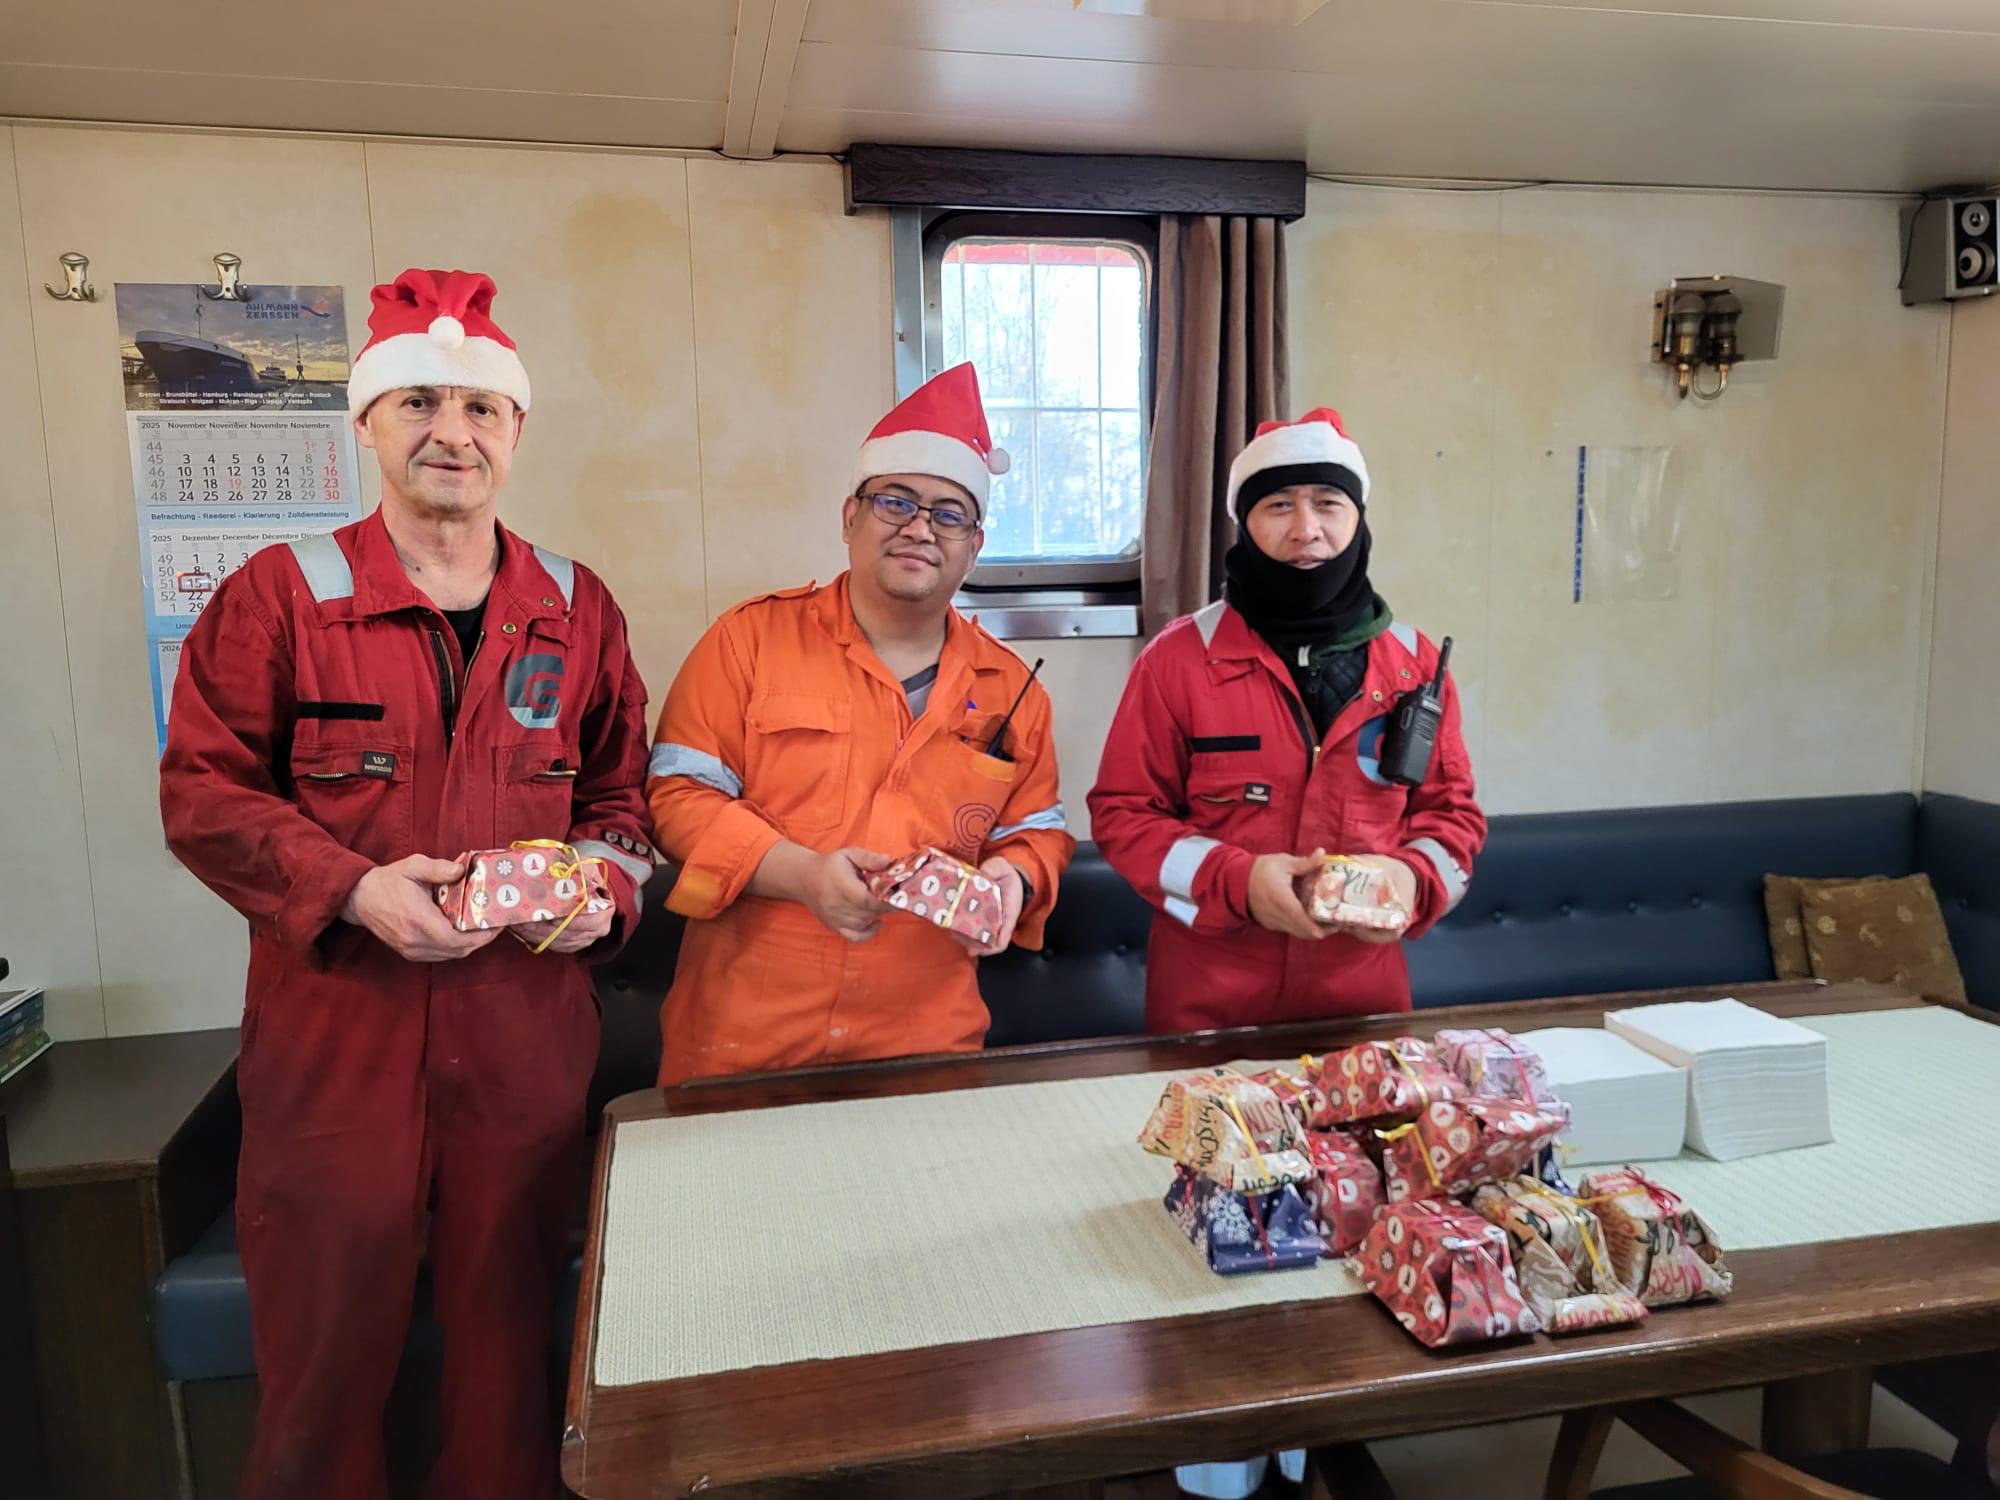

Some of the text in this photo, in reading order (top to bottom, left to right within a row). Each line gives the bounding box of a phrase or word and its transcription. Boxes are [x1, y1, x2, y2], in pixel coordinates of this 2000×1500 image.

[245, 303, 298, 311] AHLMANN
[245, 311, 299, 319] ZERSSEN
[141, 421, 331, 430] 2025 November November Novembre Noviembre
[146, 441, 162, 452] 44
[327, 441, 336, 451] 2
[147, 453, 337, 465] 45 3 4 5 6 7 8 9
[148, 466, 338, 477] 46 10 11 12 13 14 15 16
[150, 479, 166, 490] 47
[179, 479, 193, 489] 17
[204, 479, 218, 489] 18
[252, 479, 267, 489] 20
[276, 478, 290, 489] 21
[300, 478, 315, 489] 22
[324, 478, 339, 489] 23
[151, 490, 339, 502] 48 24 25 26 27 28 29 30
[151, 513, 196, 521] Befrachtung
[182, 534, 220, 542] Dezember
[222, 533, 260, 541] December
[157, 554, 174, 564] 49
[193, 554, 199, 564] 1
[217, 553, 225, 563] 2
[159, 565, 226, 577] 50 8 9
[160, 579, 175, 589] 51
[161, 591, 203, 601] 52 22
[170, 603, 204, 613] 1 29
